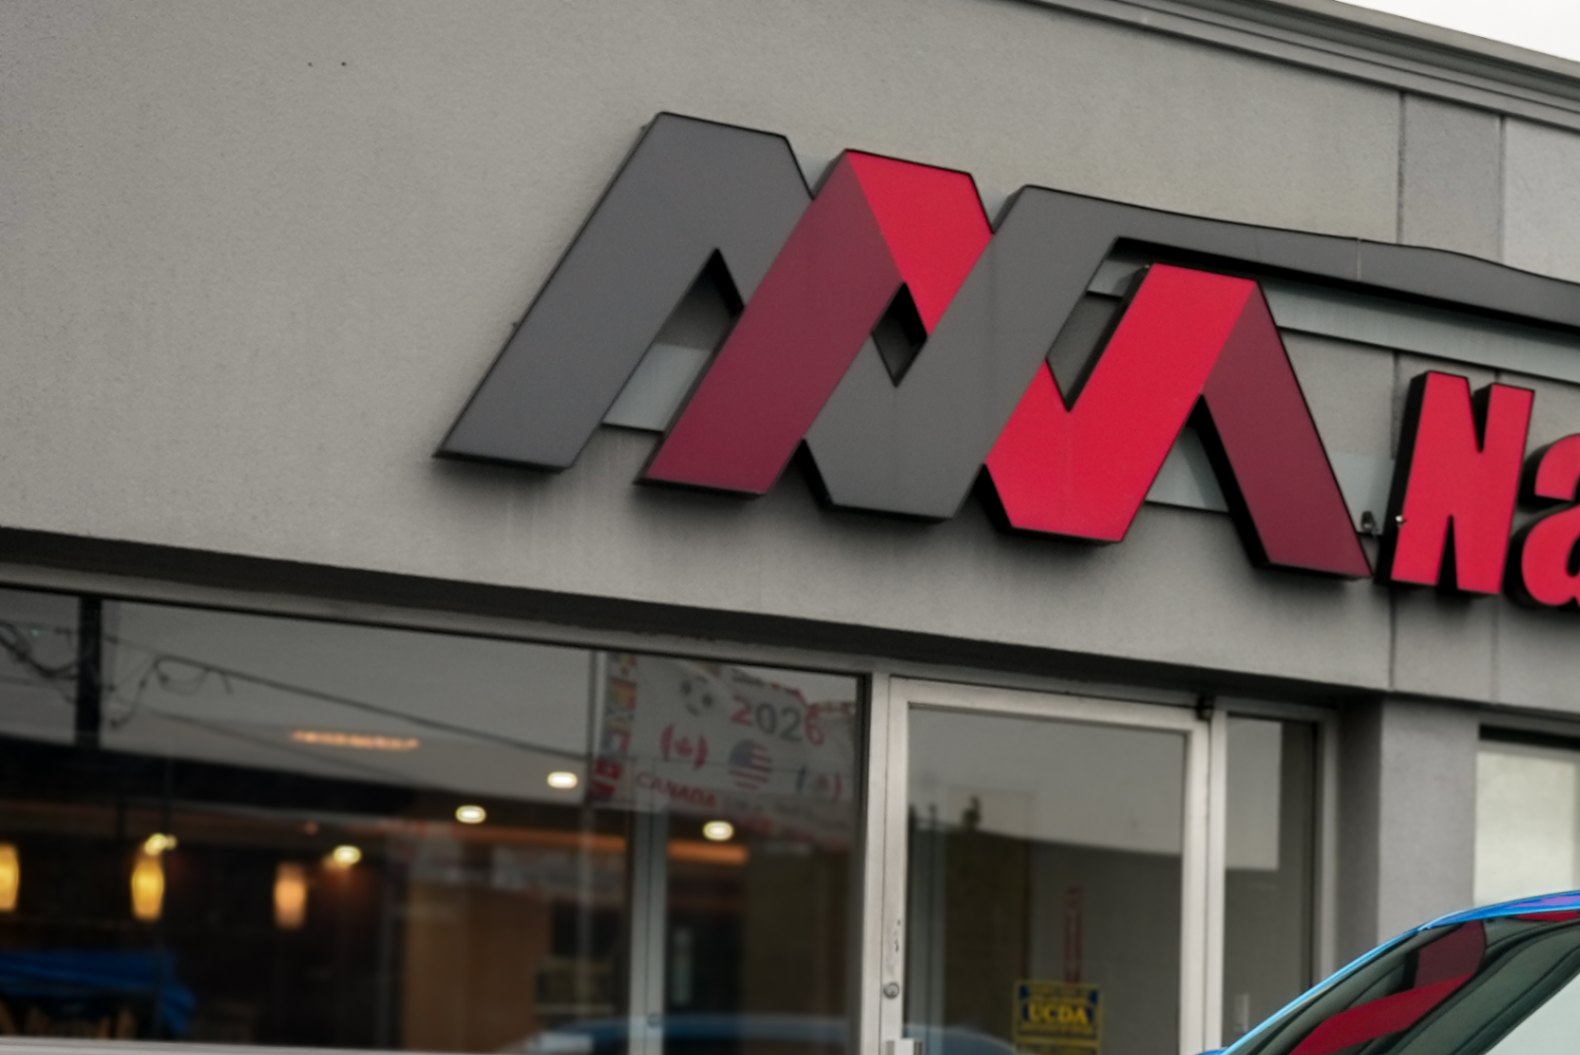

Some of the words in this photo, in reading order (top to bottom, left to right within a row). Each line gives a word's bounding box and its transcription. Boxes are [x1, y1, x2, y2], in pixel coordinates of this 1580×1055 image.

[729, 694, 826, 747] 2026
[634, 770, 718, 807] CANADA
[1027, 1002, 1089, 1026] UCDA
